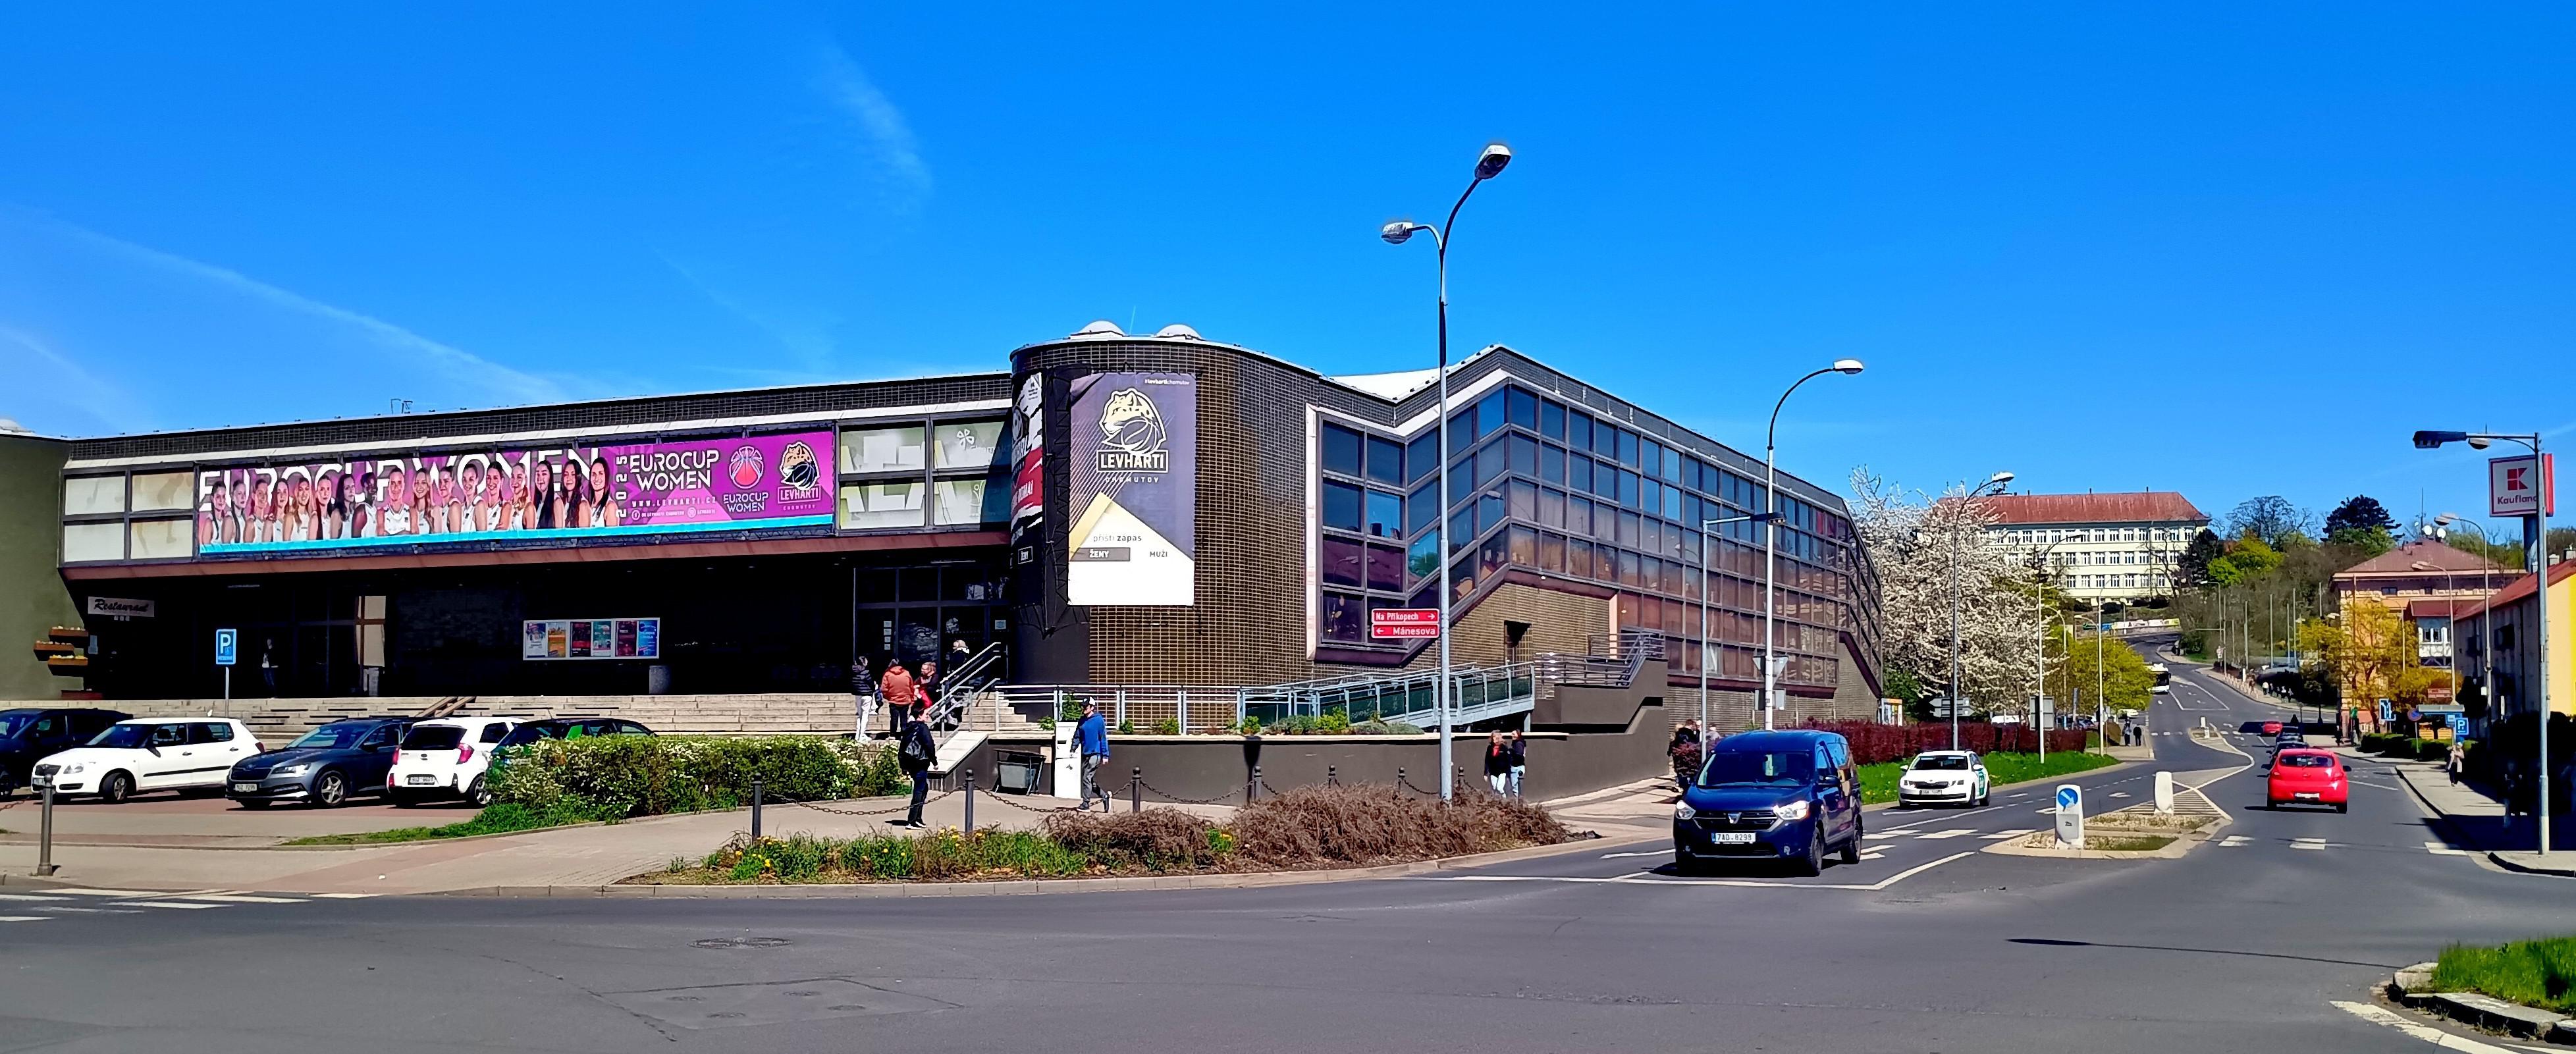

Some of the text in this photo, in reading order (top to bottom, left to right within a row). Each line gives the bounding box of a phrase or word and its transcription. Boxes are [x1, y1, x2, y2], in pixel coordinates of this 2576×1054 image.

[630, 450, 719, 473] EUROCUP
[1100, 454, 1164, 469] LEVHARTI
[636, 469, 711, 491] WOMEN
[615, 456, 628, 517] 2025
[723, 492, 768, 504] EUROCUP
[780, 488, 819, 500] LEVHARTI
[727, 502, 765, 512] WOMEN
[1089, 549, 1109, 558] ŽENY
[1150, 549, 1167, 558] MUŽI
[94, 598, 149, 612] Restaurant
[1387, 612, 1418, 622] Příkopech
[1393, 627, 1436, 635] Mánesova
[221, 634, 231, 654] P
[2457, 720, 2465, 729] P
